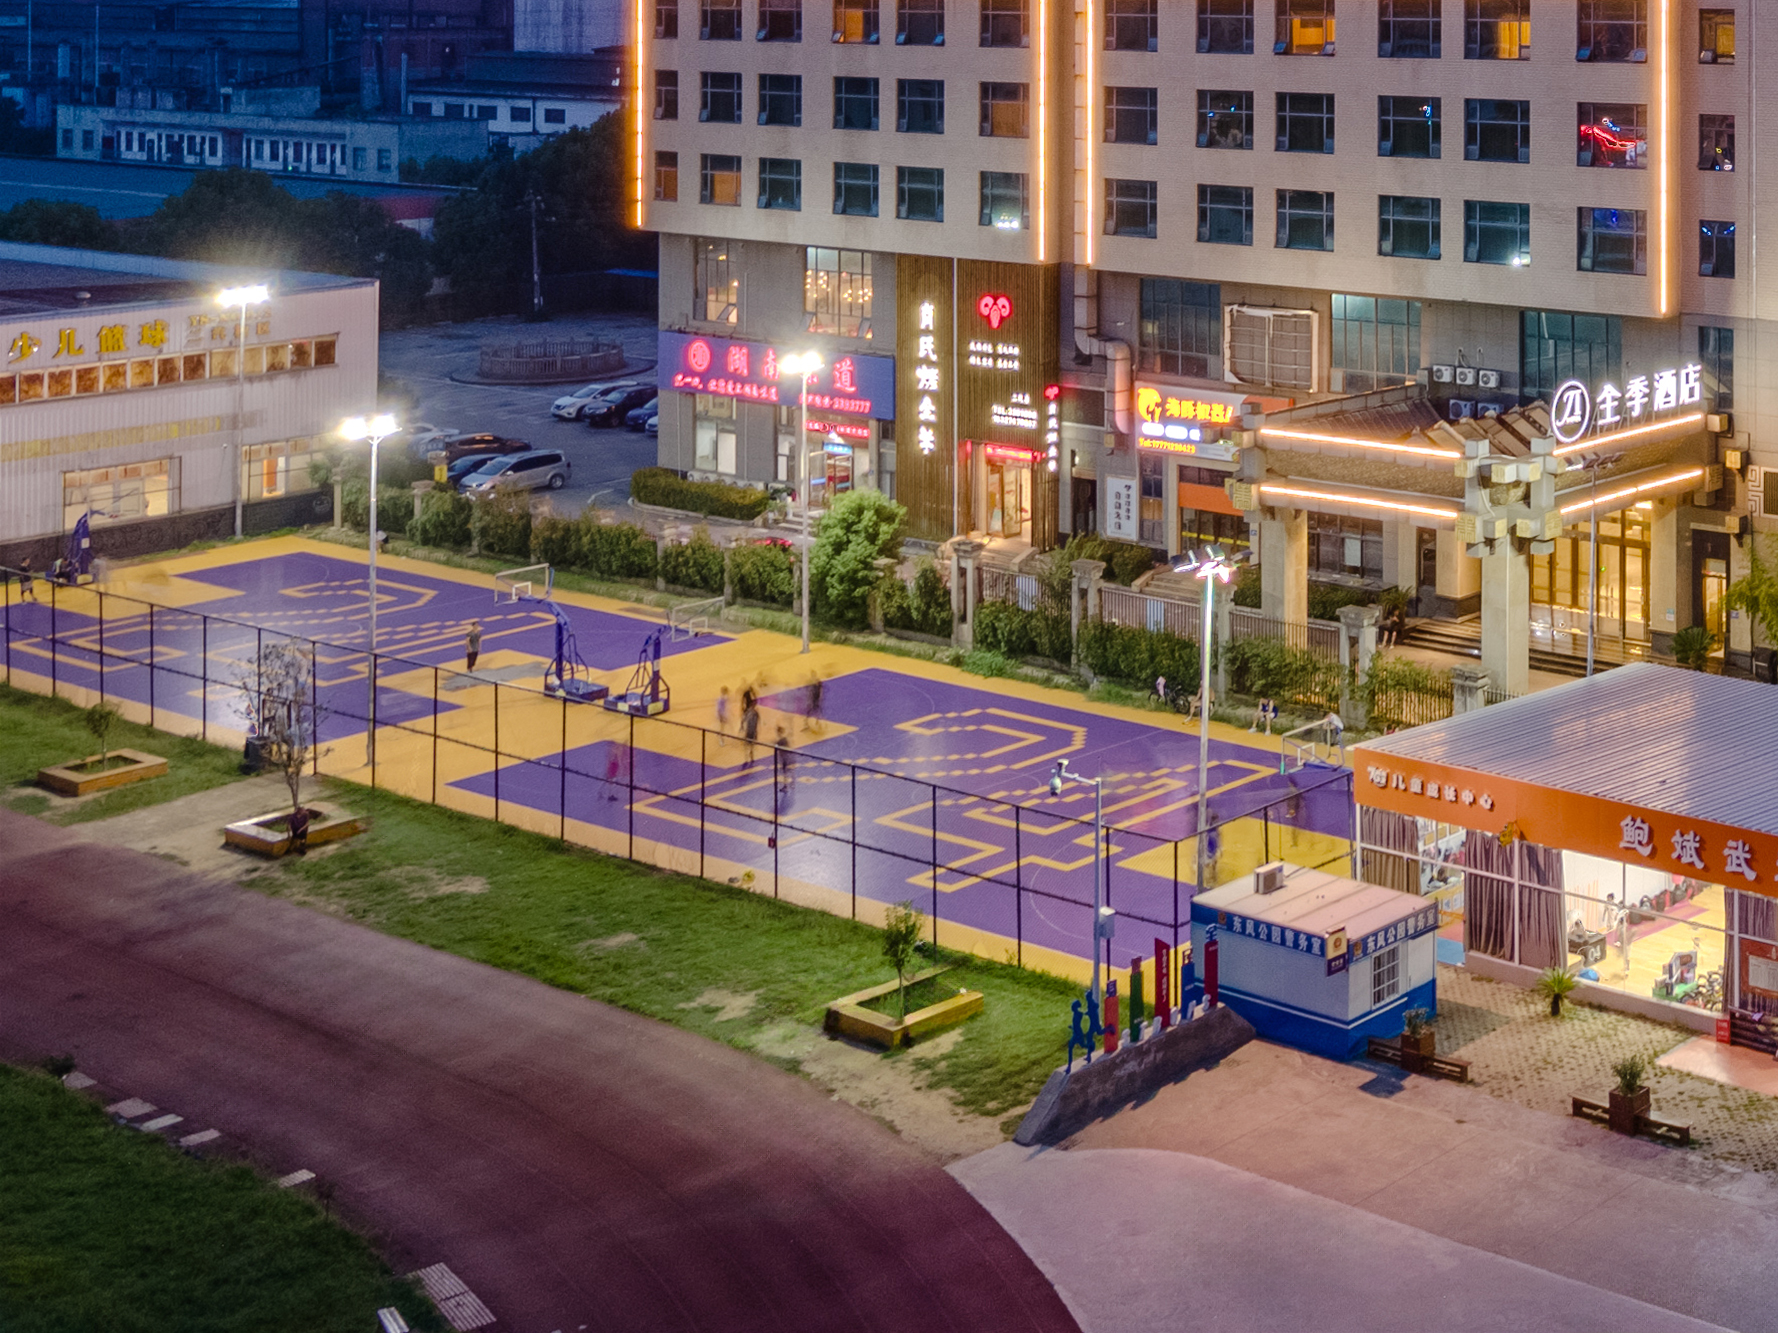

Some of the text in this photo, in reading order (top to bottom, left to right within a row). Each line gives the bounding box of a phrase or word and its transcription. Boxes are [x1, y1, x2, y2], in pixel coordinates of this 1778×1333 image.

[8, 319, 169, 364] 少儿篮球
[1596, 363, 1702, 426] 全季酒店
[1232, 915, 1321, 955] 东风公园警务室
[1366, 908, 1435, 954] 东风公园警务室
